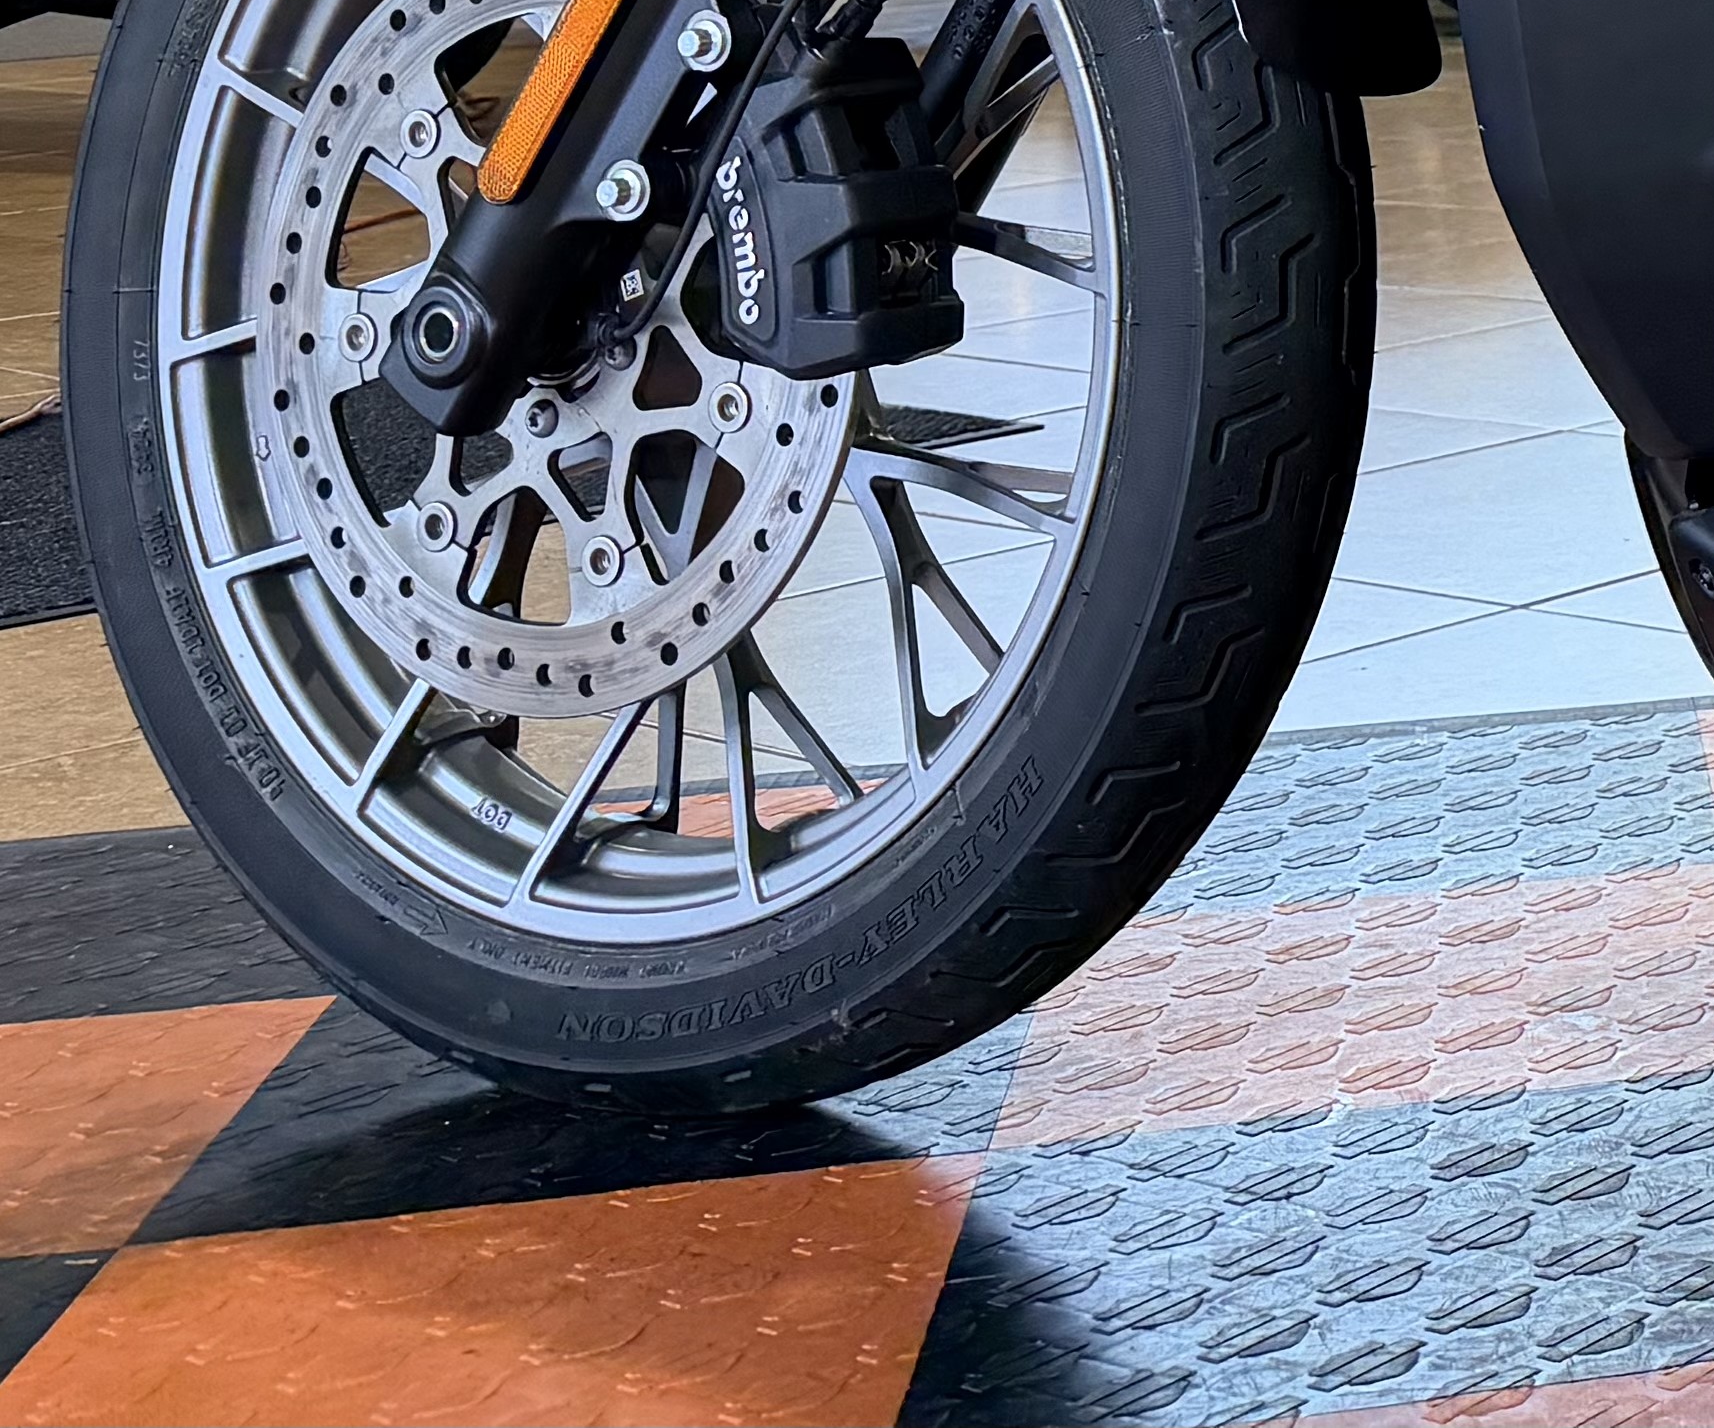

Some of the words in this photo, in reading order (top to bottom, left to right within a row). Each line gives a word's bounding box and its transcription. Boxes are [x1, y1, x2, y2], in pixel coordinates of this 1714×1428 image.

[716, 155, 765, 325] brembo
[471, 797, 512, 832] DOT
[562, 756, 1044, 1043] HARLEY-DAVIDSON
